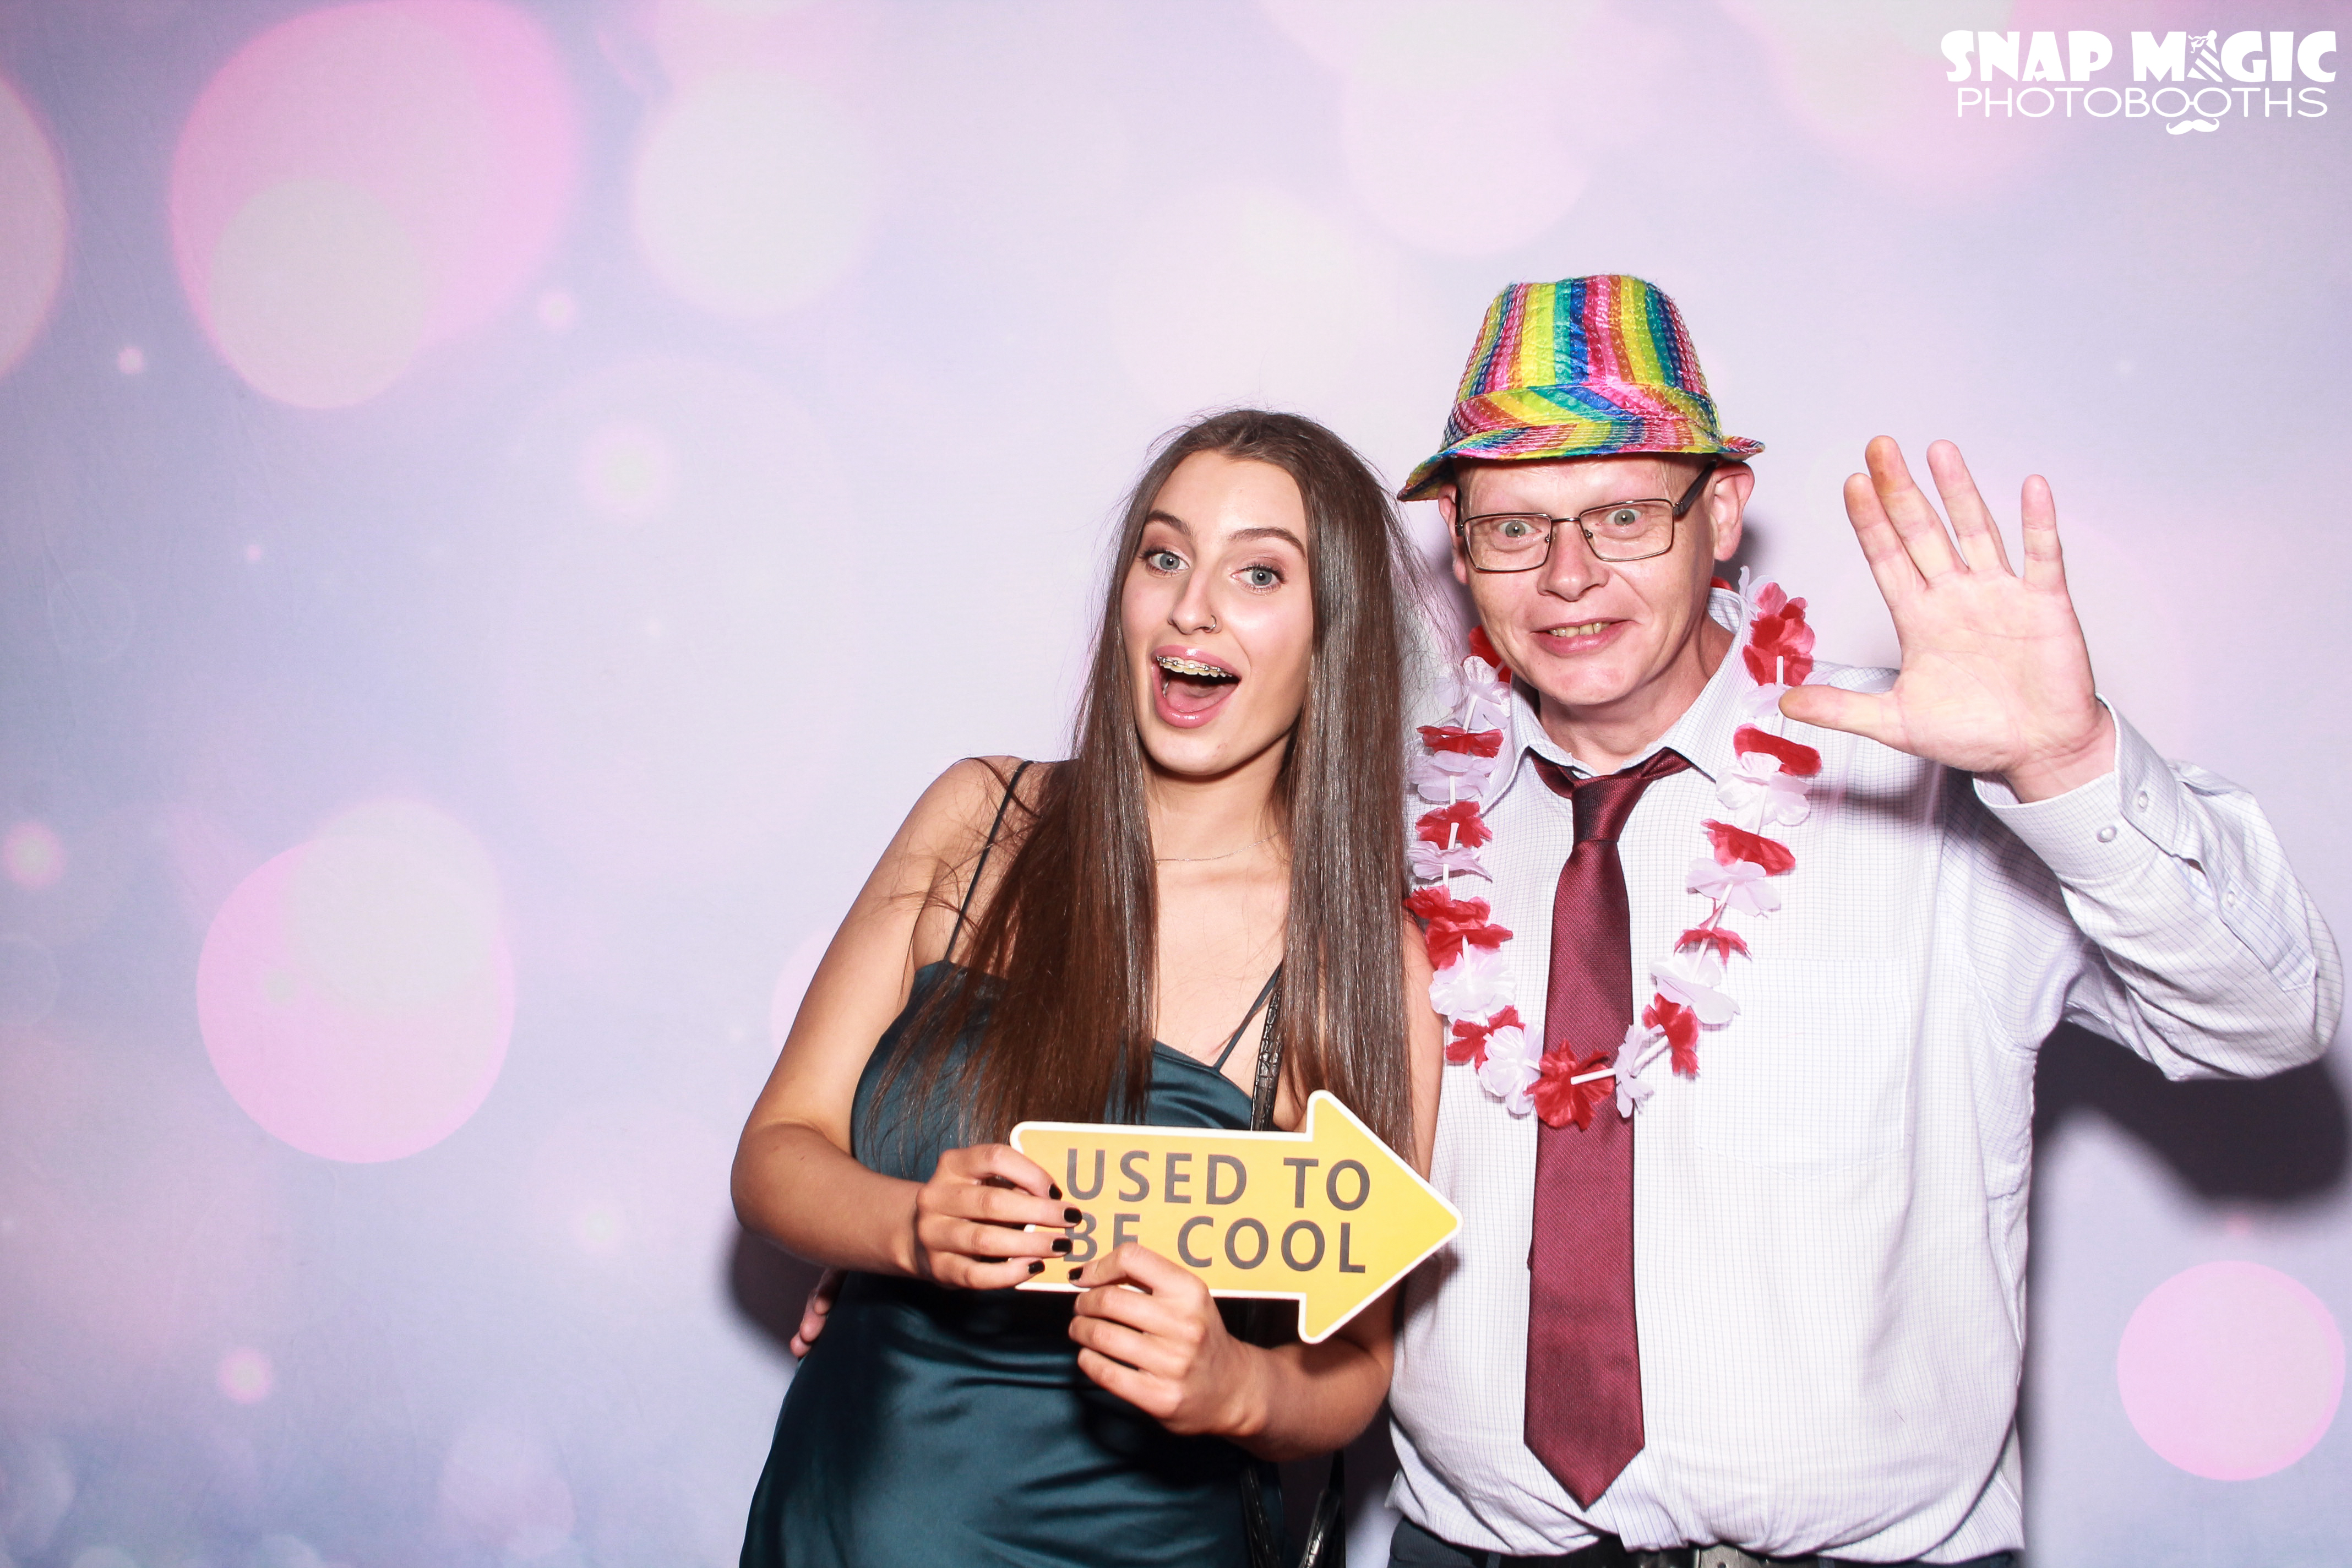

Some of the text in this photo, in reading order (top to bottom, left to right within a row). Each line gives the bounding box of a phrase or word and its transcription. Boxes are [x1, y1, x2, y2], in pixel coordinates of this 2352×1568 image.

[1066, 1148, 1371, 1211] USED TO
[1177, 1216, 1366, 1273] COOL
